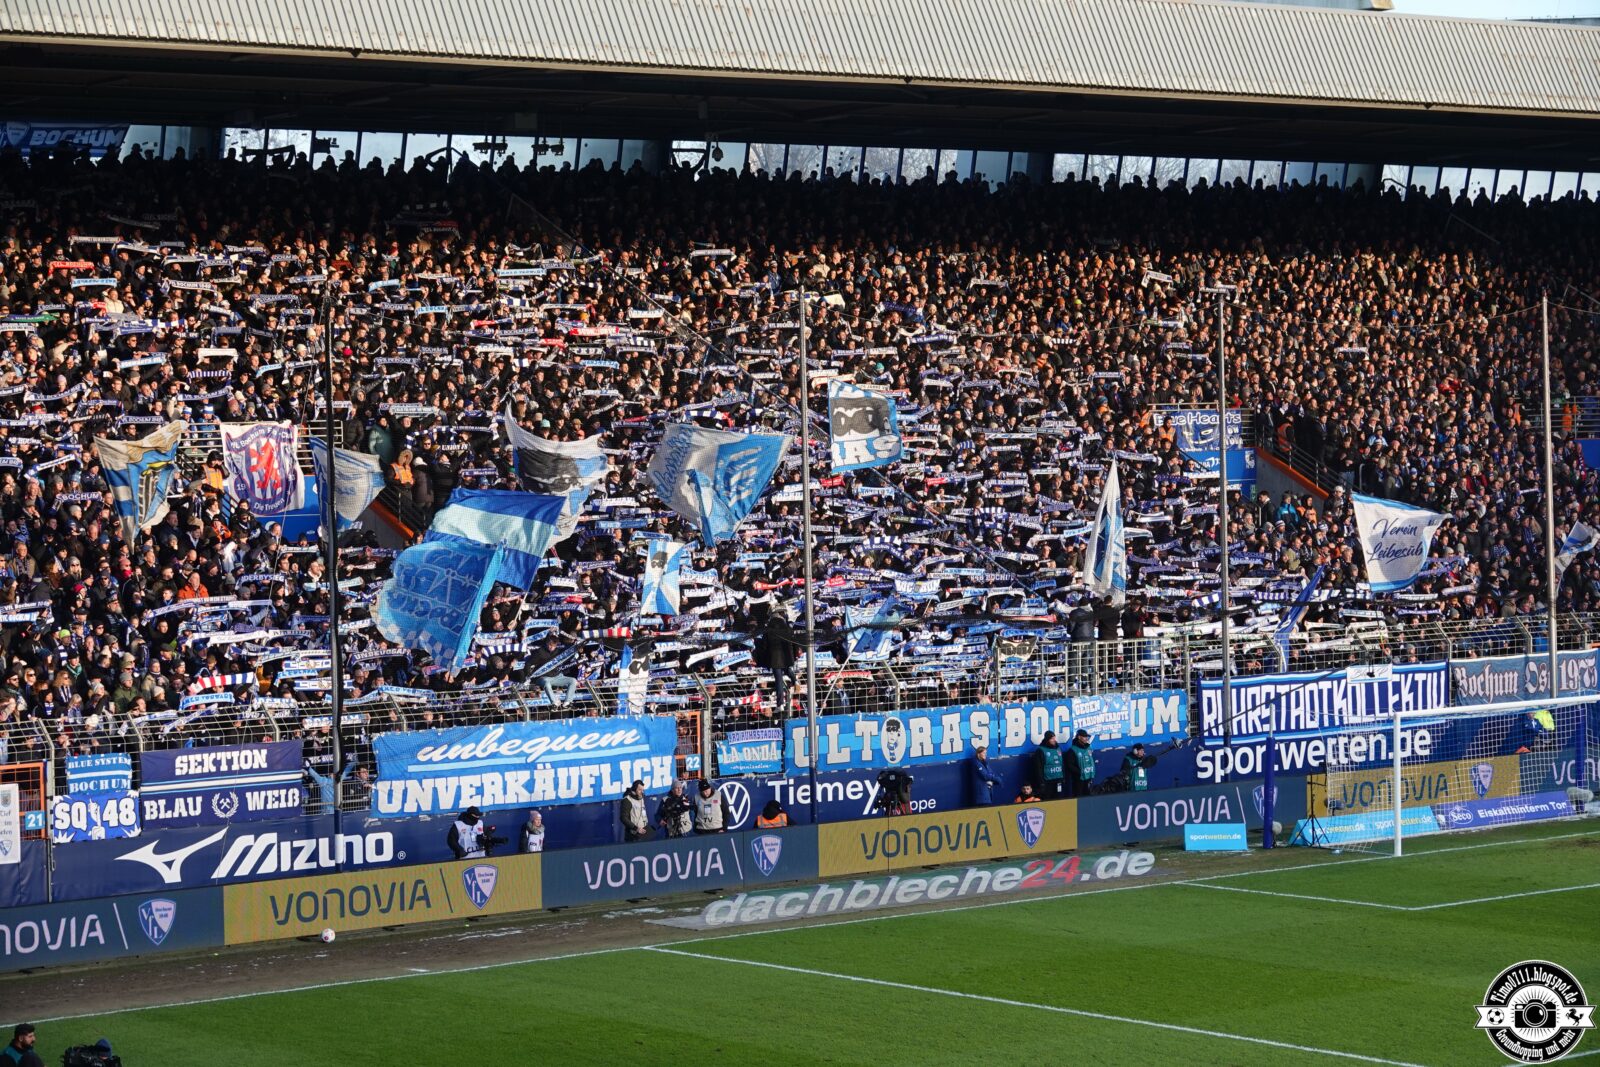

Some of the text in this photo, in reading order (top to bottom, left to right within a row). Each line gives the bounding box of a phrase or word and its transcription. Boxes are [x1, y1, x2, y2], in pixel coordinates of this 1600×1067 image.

[29, 130, 125, 146] BOCHUM
[1153, 411, 1242, 426] Bue Heats
[240, 428, 265, 447] Bochum
[1372, 518, 1418, 539] Verein
[1453, 664, 1519, 700] Bochum
[1525, 661, 1551, 695] Os
[1005, 695, 1181, 748] BOCUM
[417, 726, 641, 765] unbequem
[68, 757, 132, 769] BLUE SYSTEM
[174, 749, 268, 776] SEKTION
[686, 756, 700, 770] 22
[69, 778, 132, 794] BOCHUM
[377, 754, 673, 815] UNVERKÄUFLICH
[54, 797, 137, 832] SQ 48
[144, 796, 203, 821] BLAU
[1551, 801, 1568, 812] Tor
[27, 813, 44, 828] 21
[703, 816, 714, 824] TV
[1449, 809, 1472, 824] Seco
[1189, 832, 1242, 842] sportwetten.de
[702, 849, 1156, 926] dachbleche24.de
